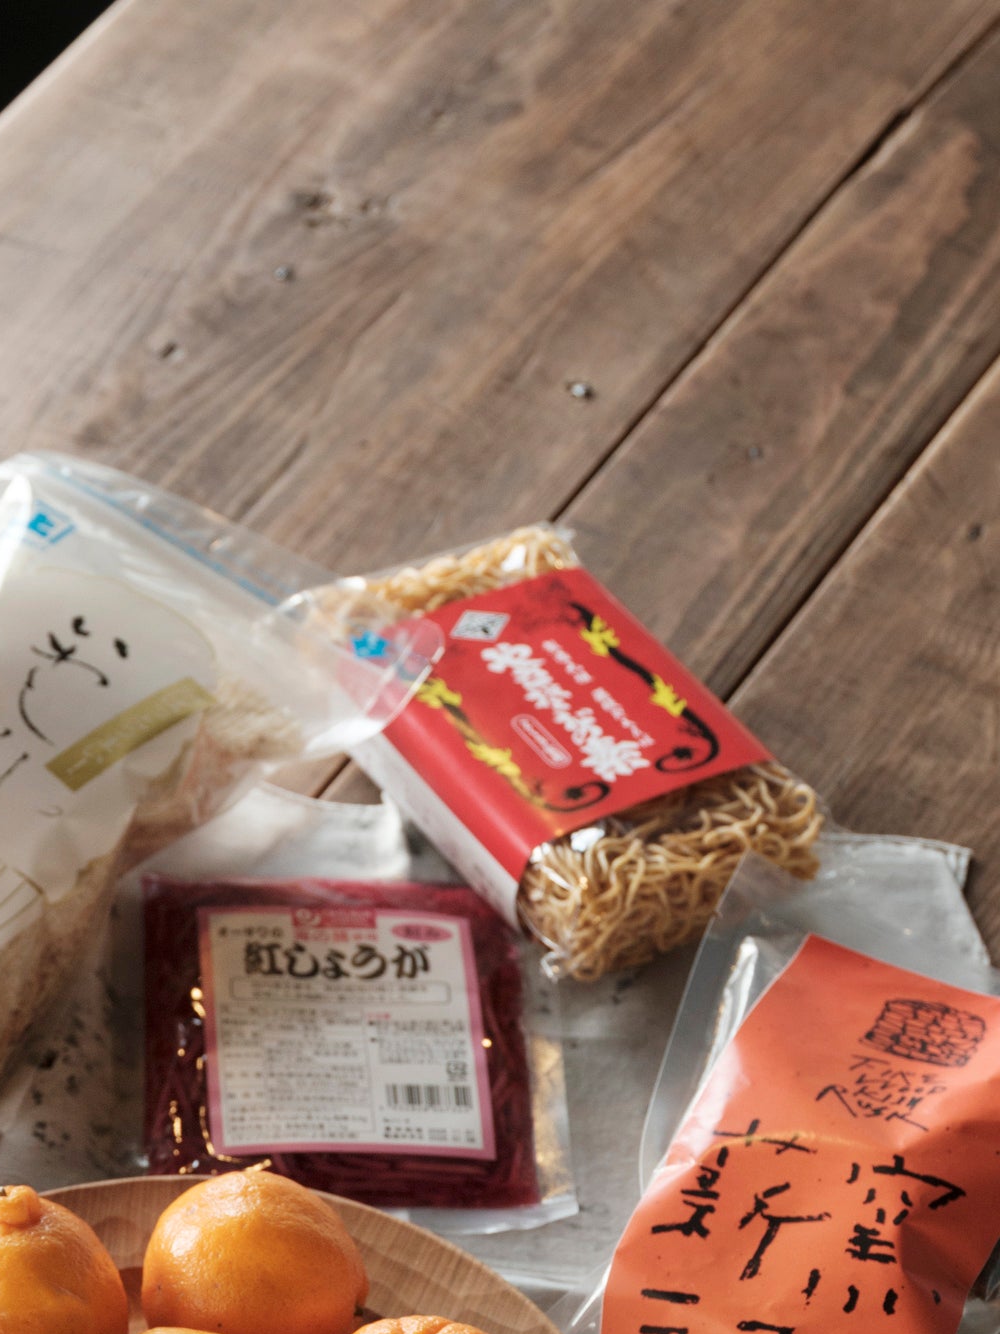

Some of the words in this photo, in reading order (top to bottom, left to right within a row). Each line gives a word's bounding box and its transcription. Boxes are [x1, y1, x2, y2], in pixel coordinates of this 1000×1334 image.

[244, 943, 431, 979] 紅しょうが
